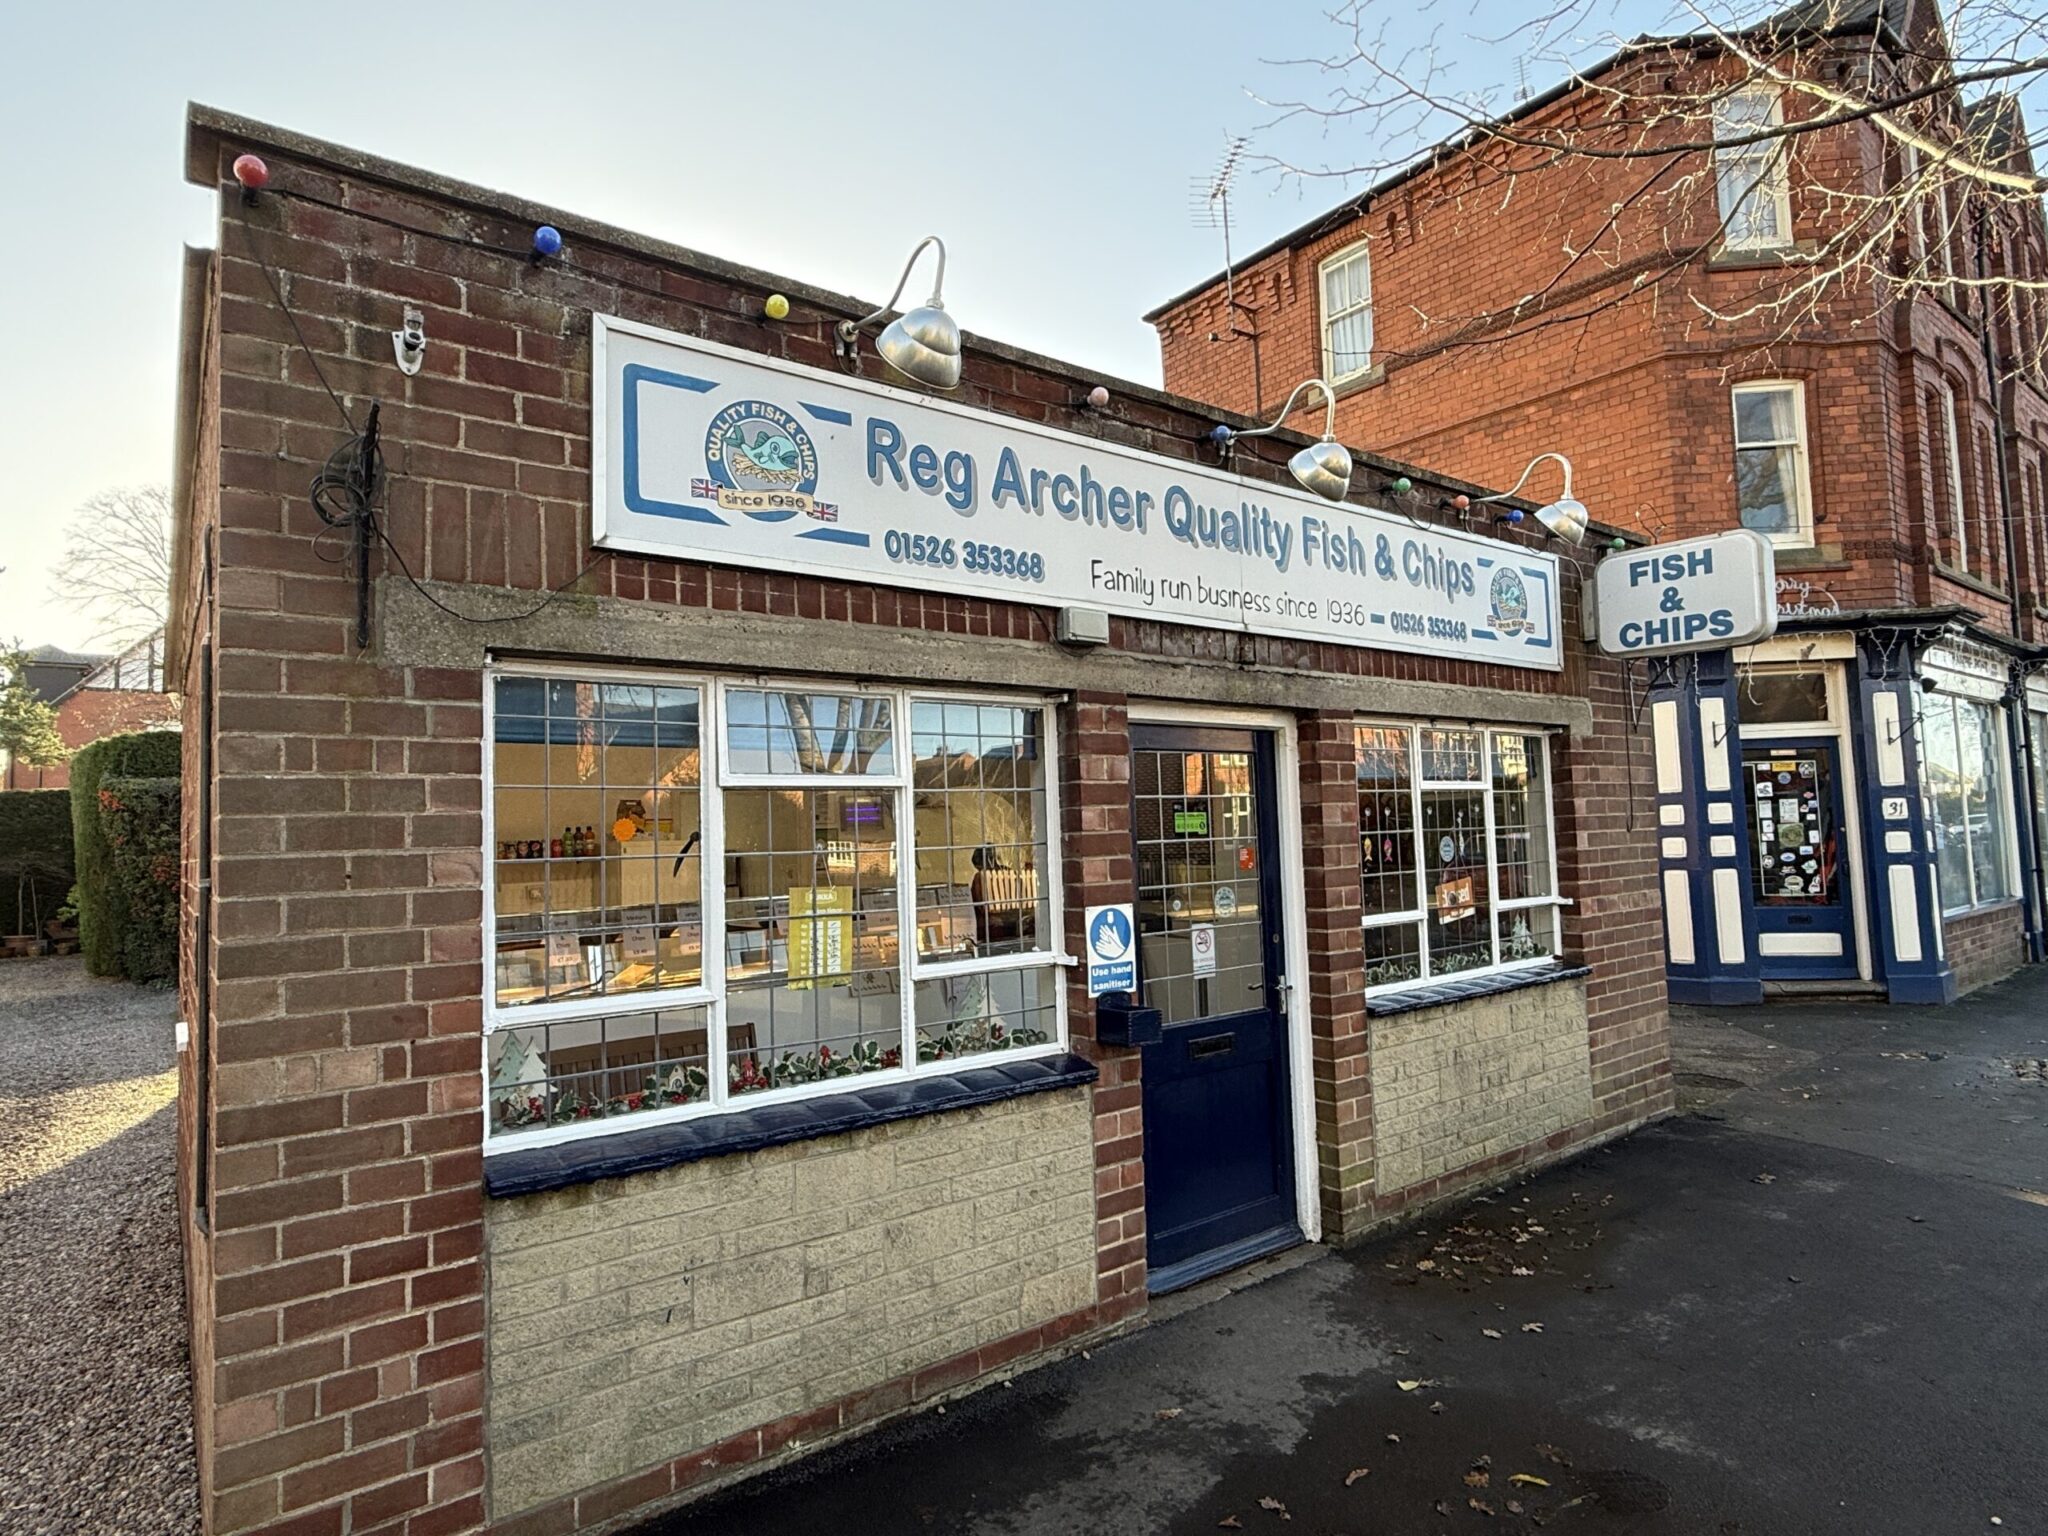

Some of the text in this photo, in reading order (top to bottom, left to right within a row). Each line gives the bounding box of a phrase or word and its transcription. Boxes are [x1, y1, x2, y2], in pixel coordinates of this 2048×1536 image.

[708, 403, 815, 480] QUALITY FISH & CHIPS
[724, 492, 806, 509] since 1936
[866, 416, 1474, 601] Reg Archer Quality Fish & Chips
[884, 529, 1044, 581] 01526 353368
[1629, 548, 1713, 587] FISH
[1091, 559, 1366, 626] Family run business since 1936
[1660, 586, 1685, 613] &
[1775, 577, 1809, 598] erry
[1777, 601, 1839, 616] ristmas
[1390, 611, 1467, 641] 01526 353368
[1619, 609, 1734, 648] CHIPS
[1888, 801, 1903, 817] 31
[1092, 963, 1132, 977] Use hand
[1093, 979, 1131, 991] sanitiser
